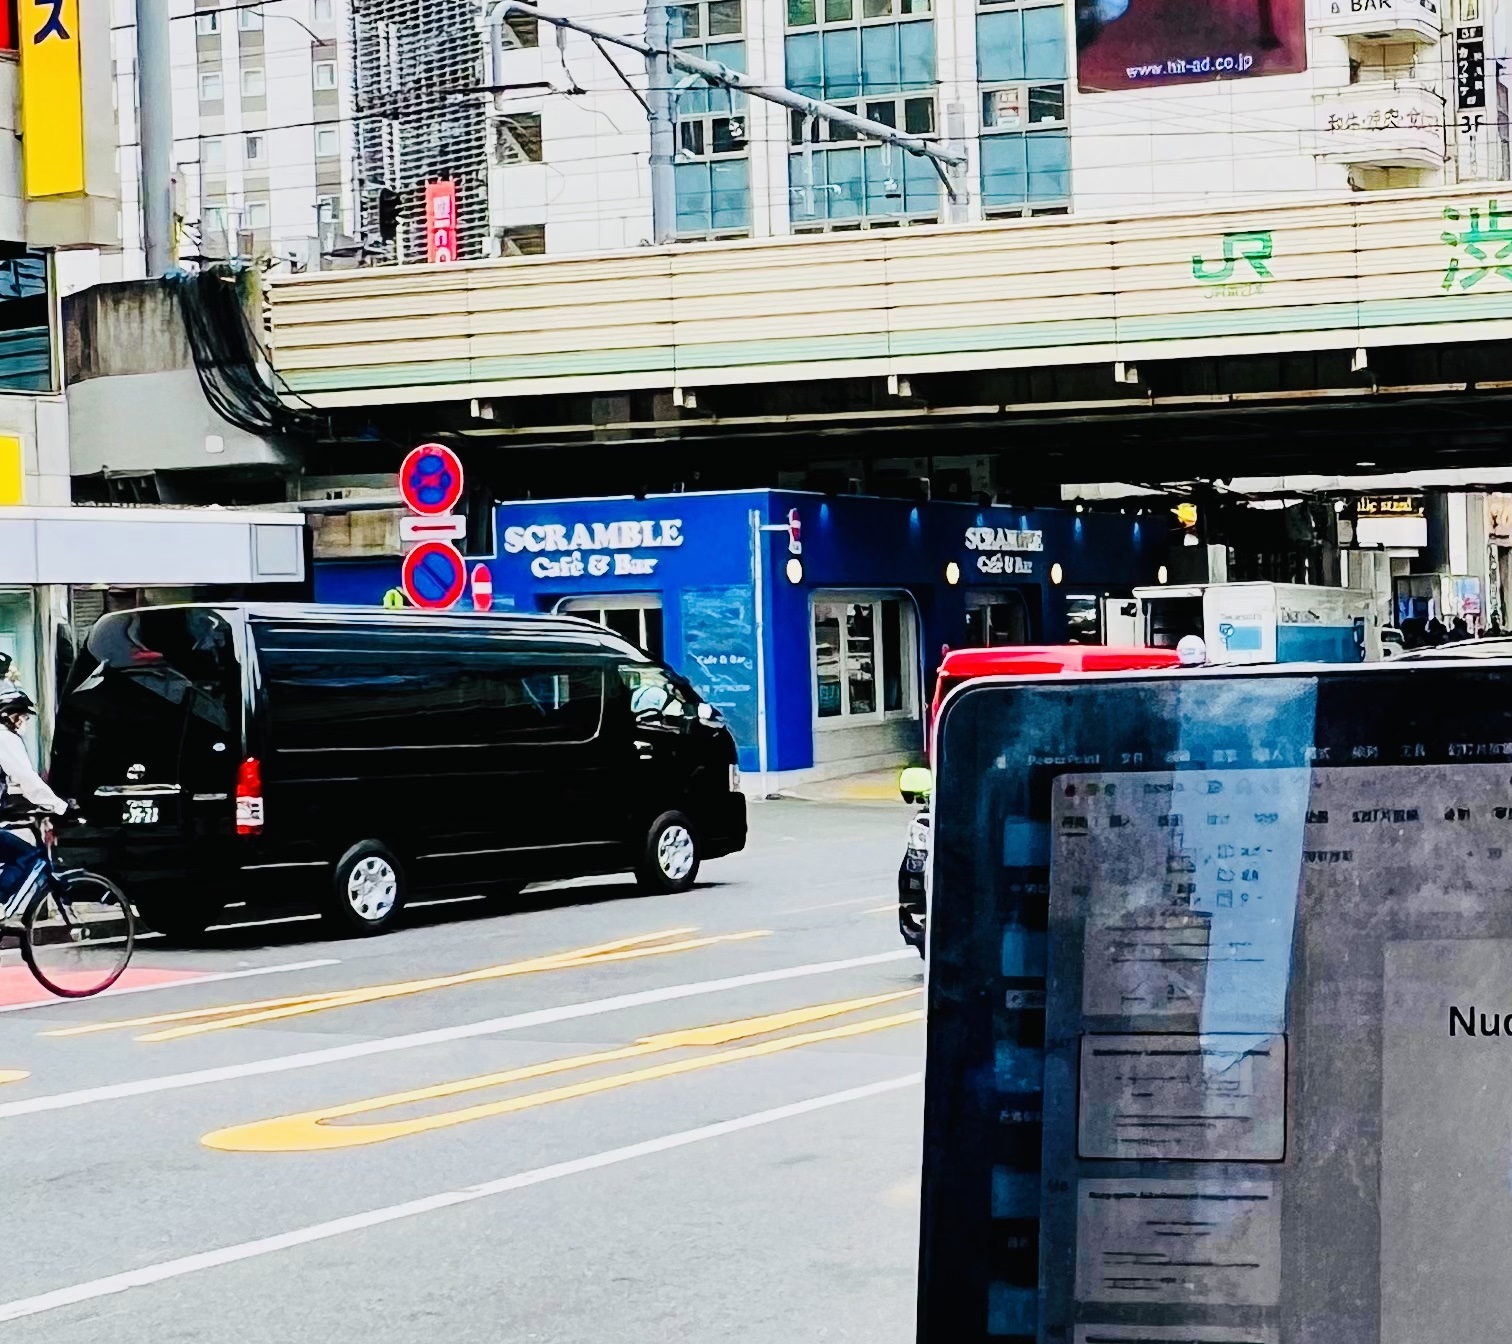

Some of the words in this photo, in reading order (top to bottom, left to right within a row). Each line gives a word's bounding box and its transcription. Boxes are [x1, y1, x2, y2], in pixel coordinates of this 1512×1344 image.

[1126, 52, 1253, 79] www.hit-ad.co.jp
[1192, 230, 1274, 283] JR
[504, 519, 684, 553] SCRAMBLE
[614, 554, 658, 575] Bar
